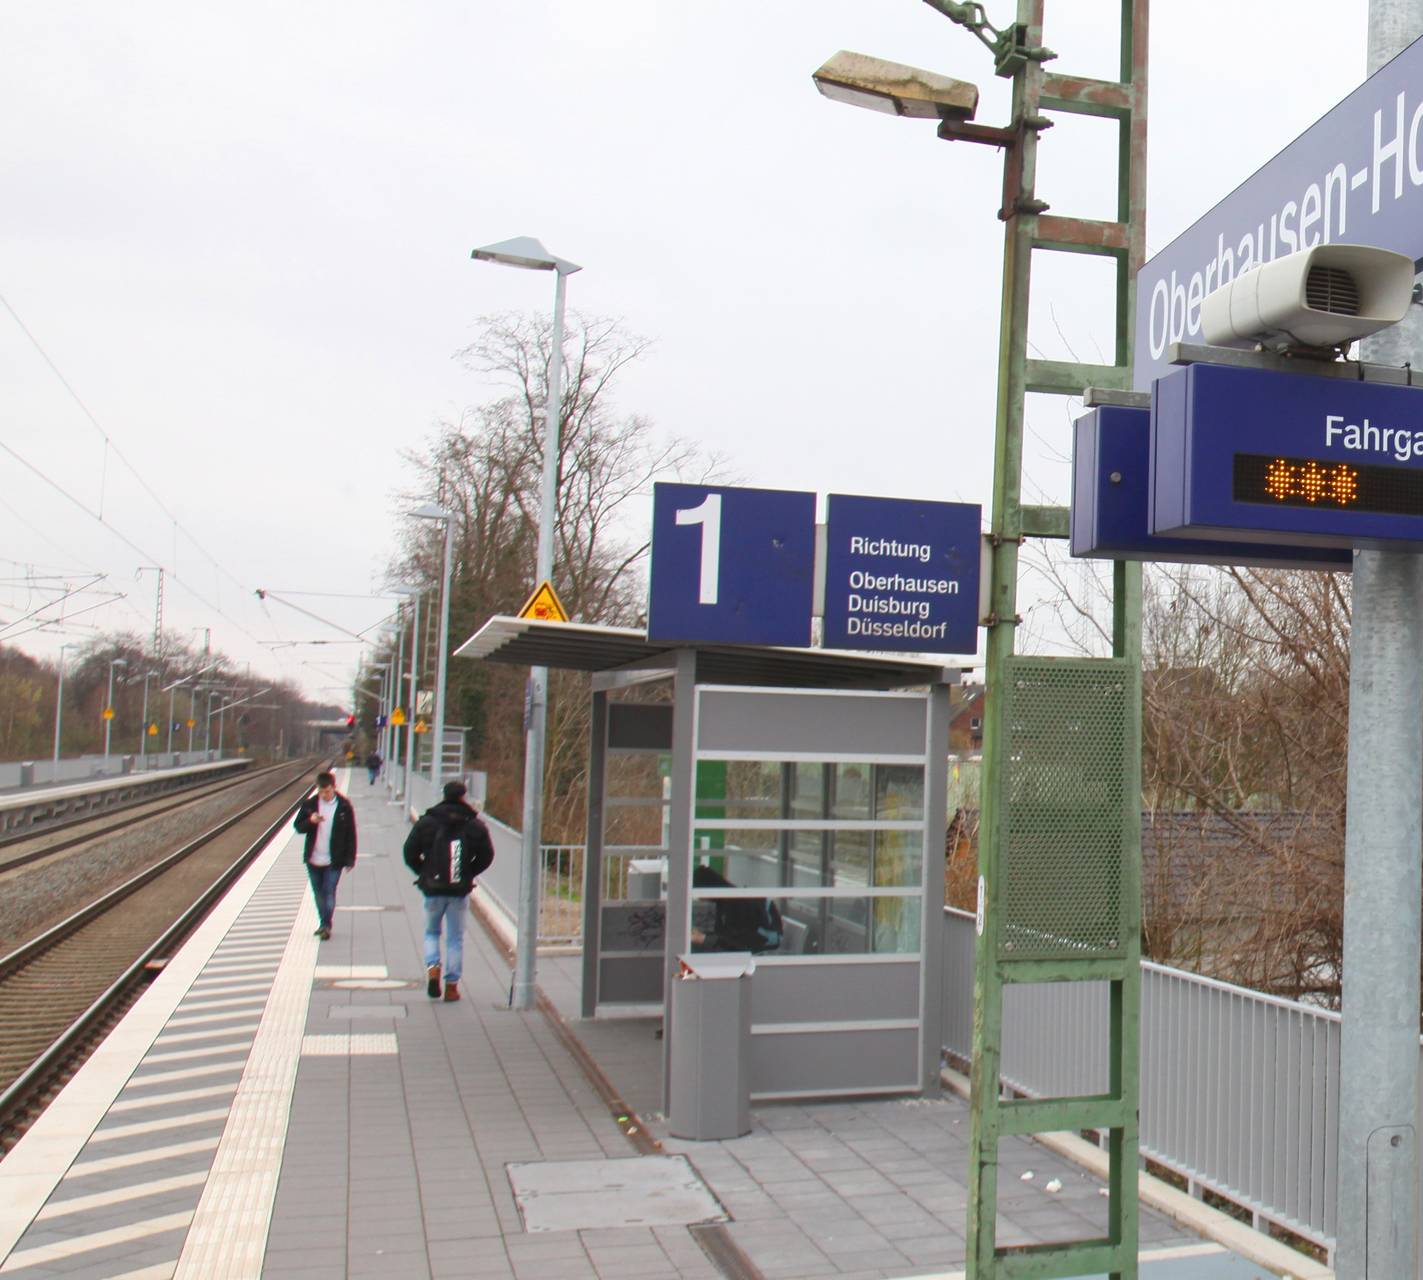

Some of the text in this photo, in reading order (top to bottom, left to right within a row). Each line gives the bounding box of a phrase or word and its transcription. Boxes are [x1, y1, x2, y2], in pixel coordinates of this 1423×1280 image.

[675, 493, 722, 605] 1
[850, 537, 931, 563] Richtung
[849, 571, 959, 595] Oberhausen
[848, 595, 930, 619] Duisburg
[847, 617, 947, 640] Düsseldorf
